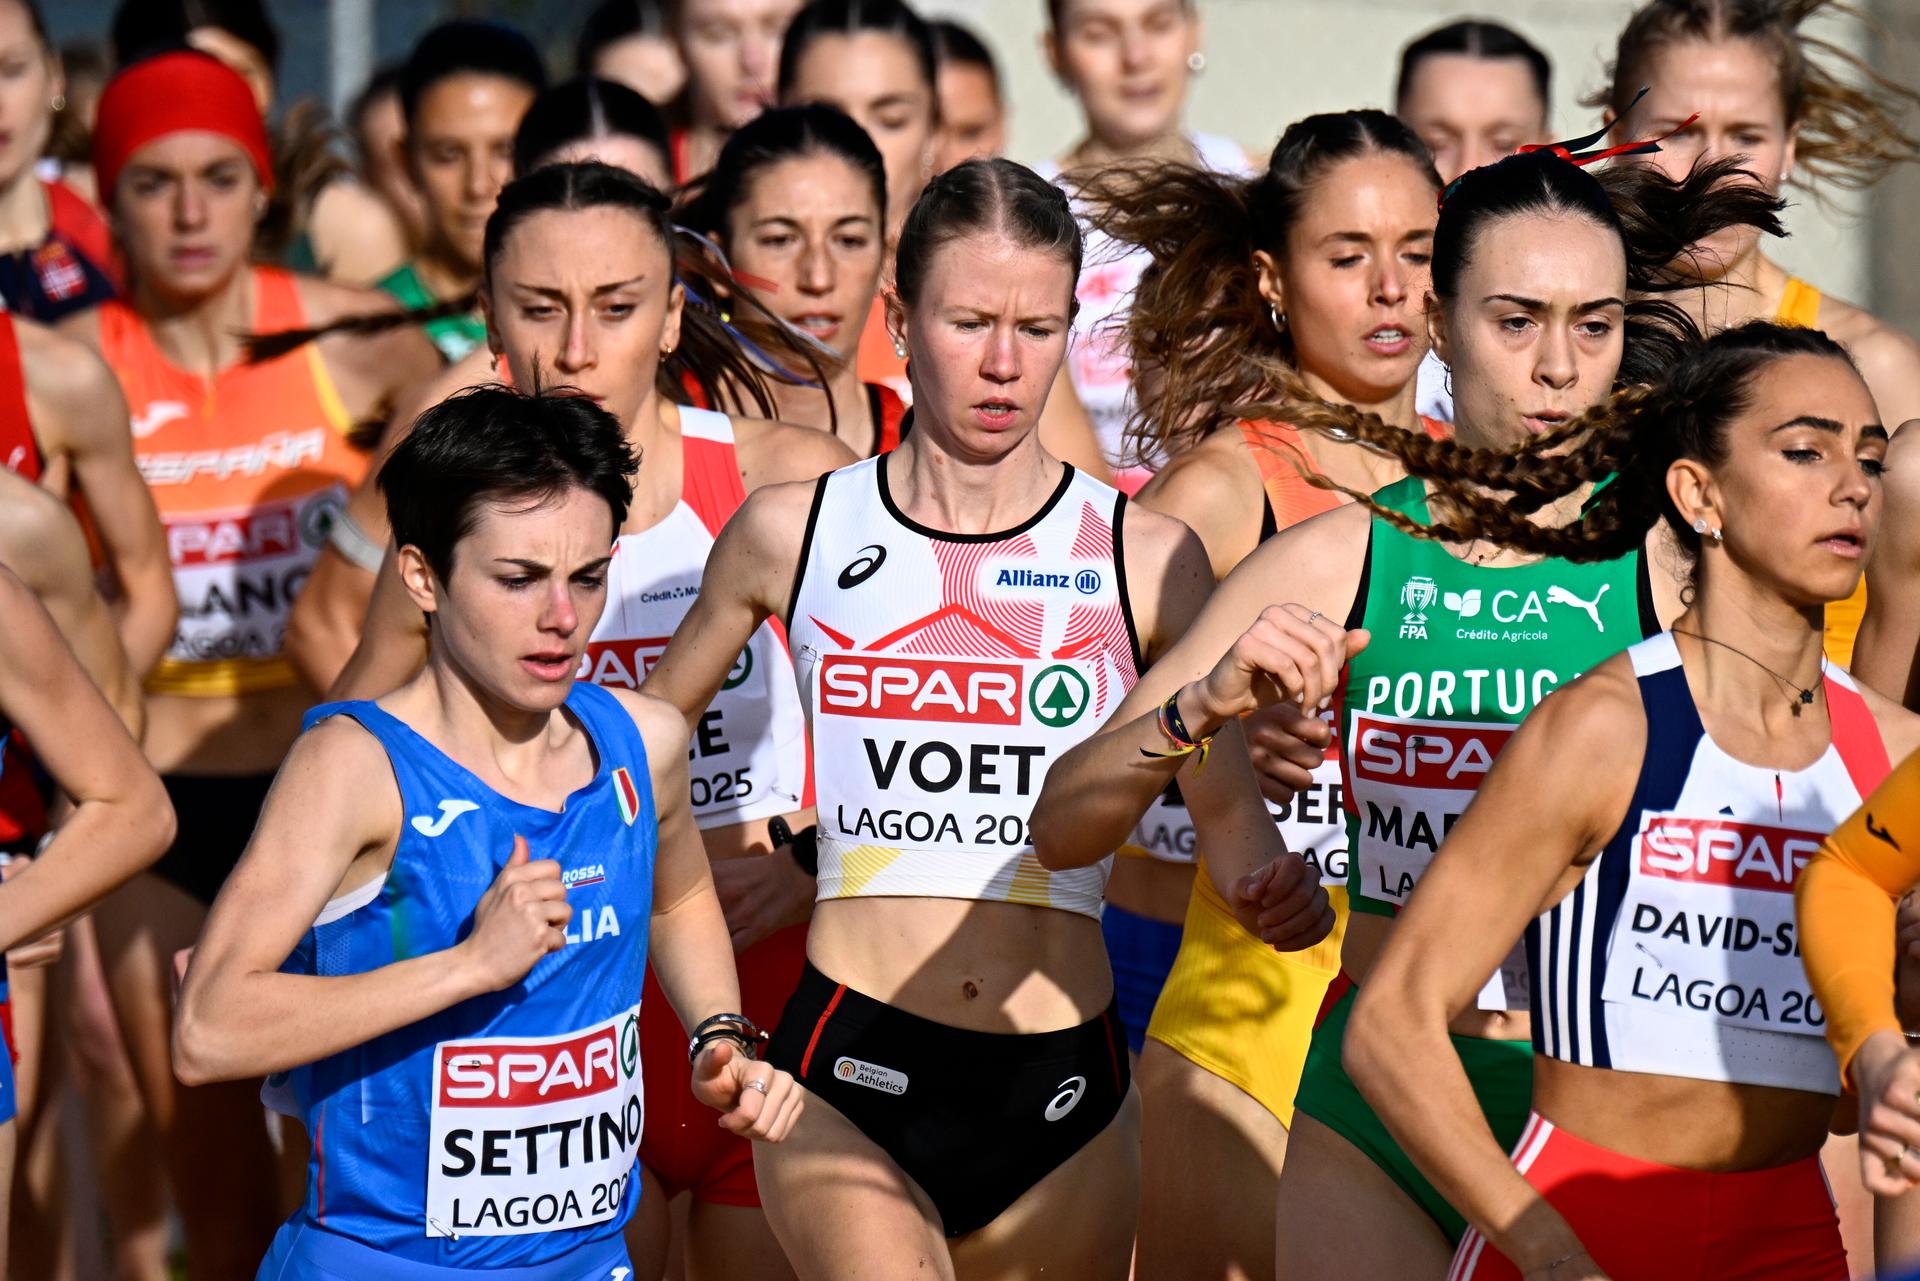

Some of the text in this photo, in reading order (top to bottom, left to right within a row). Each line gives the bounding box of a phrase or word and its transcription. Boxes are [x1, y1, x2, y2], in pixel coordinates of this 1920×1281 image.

[640, 591, 672, 603] Crédit
[996, 570, 1070, 588] Allianz
[1492, 590, 1548, 623] CA
[1399, 625, 1428, 640] FPA
[1456, 629, 1548, 643] Crédito Agrícola
[825, 664, 1016, 717] SPAR
[1366, 668, 1582, 719] PORTUG
[863, 738, 1046, 796] VOET
[1360, 728, 1493, 781] SPA
[838, 804, 963, 844] LAGOA
[562, 864, 605, 884] ROSSA
[1631, 902, 1804, 958] DAVID-S
[1632, 967, 1770, 1021] LAGOA
[446, 1037, 615, 1099] SPAR
[856, 1073, 903, 1093] Athletics
[859, 1063, 888, 1077] Belgian
[441, 1094, 642, 1178] SETTINO
[452, 1189, 583, 1229] LAGOA
